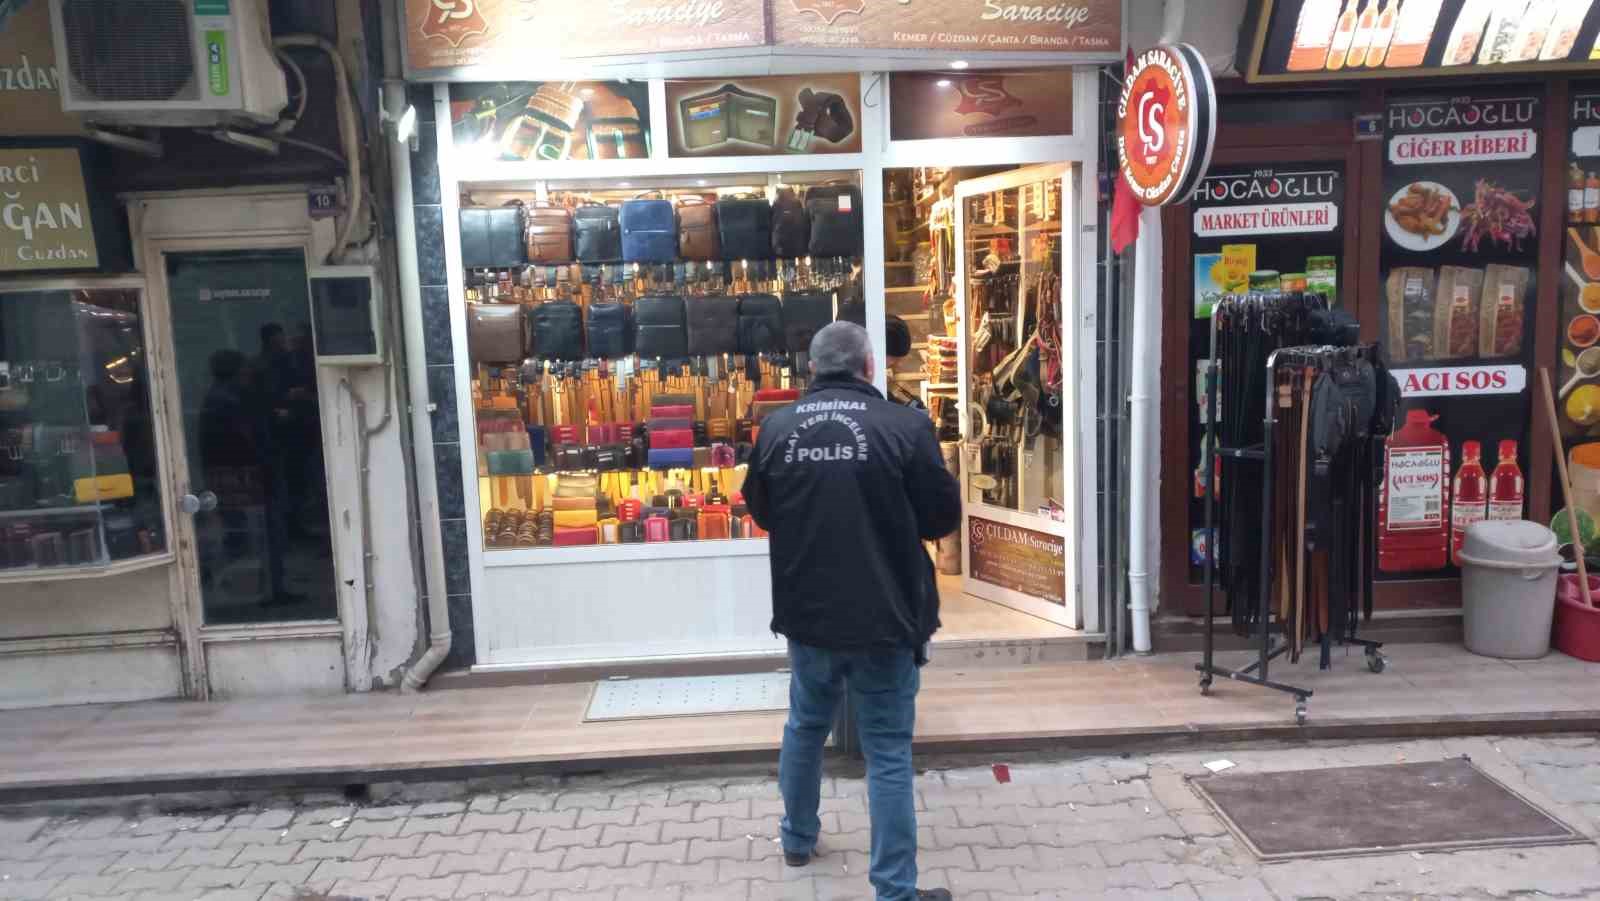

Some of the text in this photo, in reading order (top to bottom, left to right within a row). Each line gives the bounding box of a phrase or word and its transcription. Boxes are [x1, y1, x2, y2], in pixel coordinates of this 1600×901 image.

[981, 0, 1088, 29] Saraciye
[893, 31, 928, 43] KEMER
[937, 32, 977, 44] CÜZDAN
[987, 34, 1019, 46] ÇANTA
[1030, 34, 1068, 45] BRANDA
[1396, 132, 1528, 159] CİĞER BİBERİ
[315, 193, 330, 209] 10
[1201, 205, 1329, 232] MARKET ÜRÜNLERİ
[1403, 370, 1507, 393] ACI SOS
[796, 398, 868, 414] KRİMİNAL
[784, 431, 801, 463] OLAY
[831, 411, 868, 461] İNCELEME
[797, 443, 854, 462] POLİS
